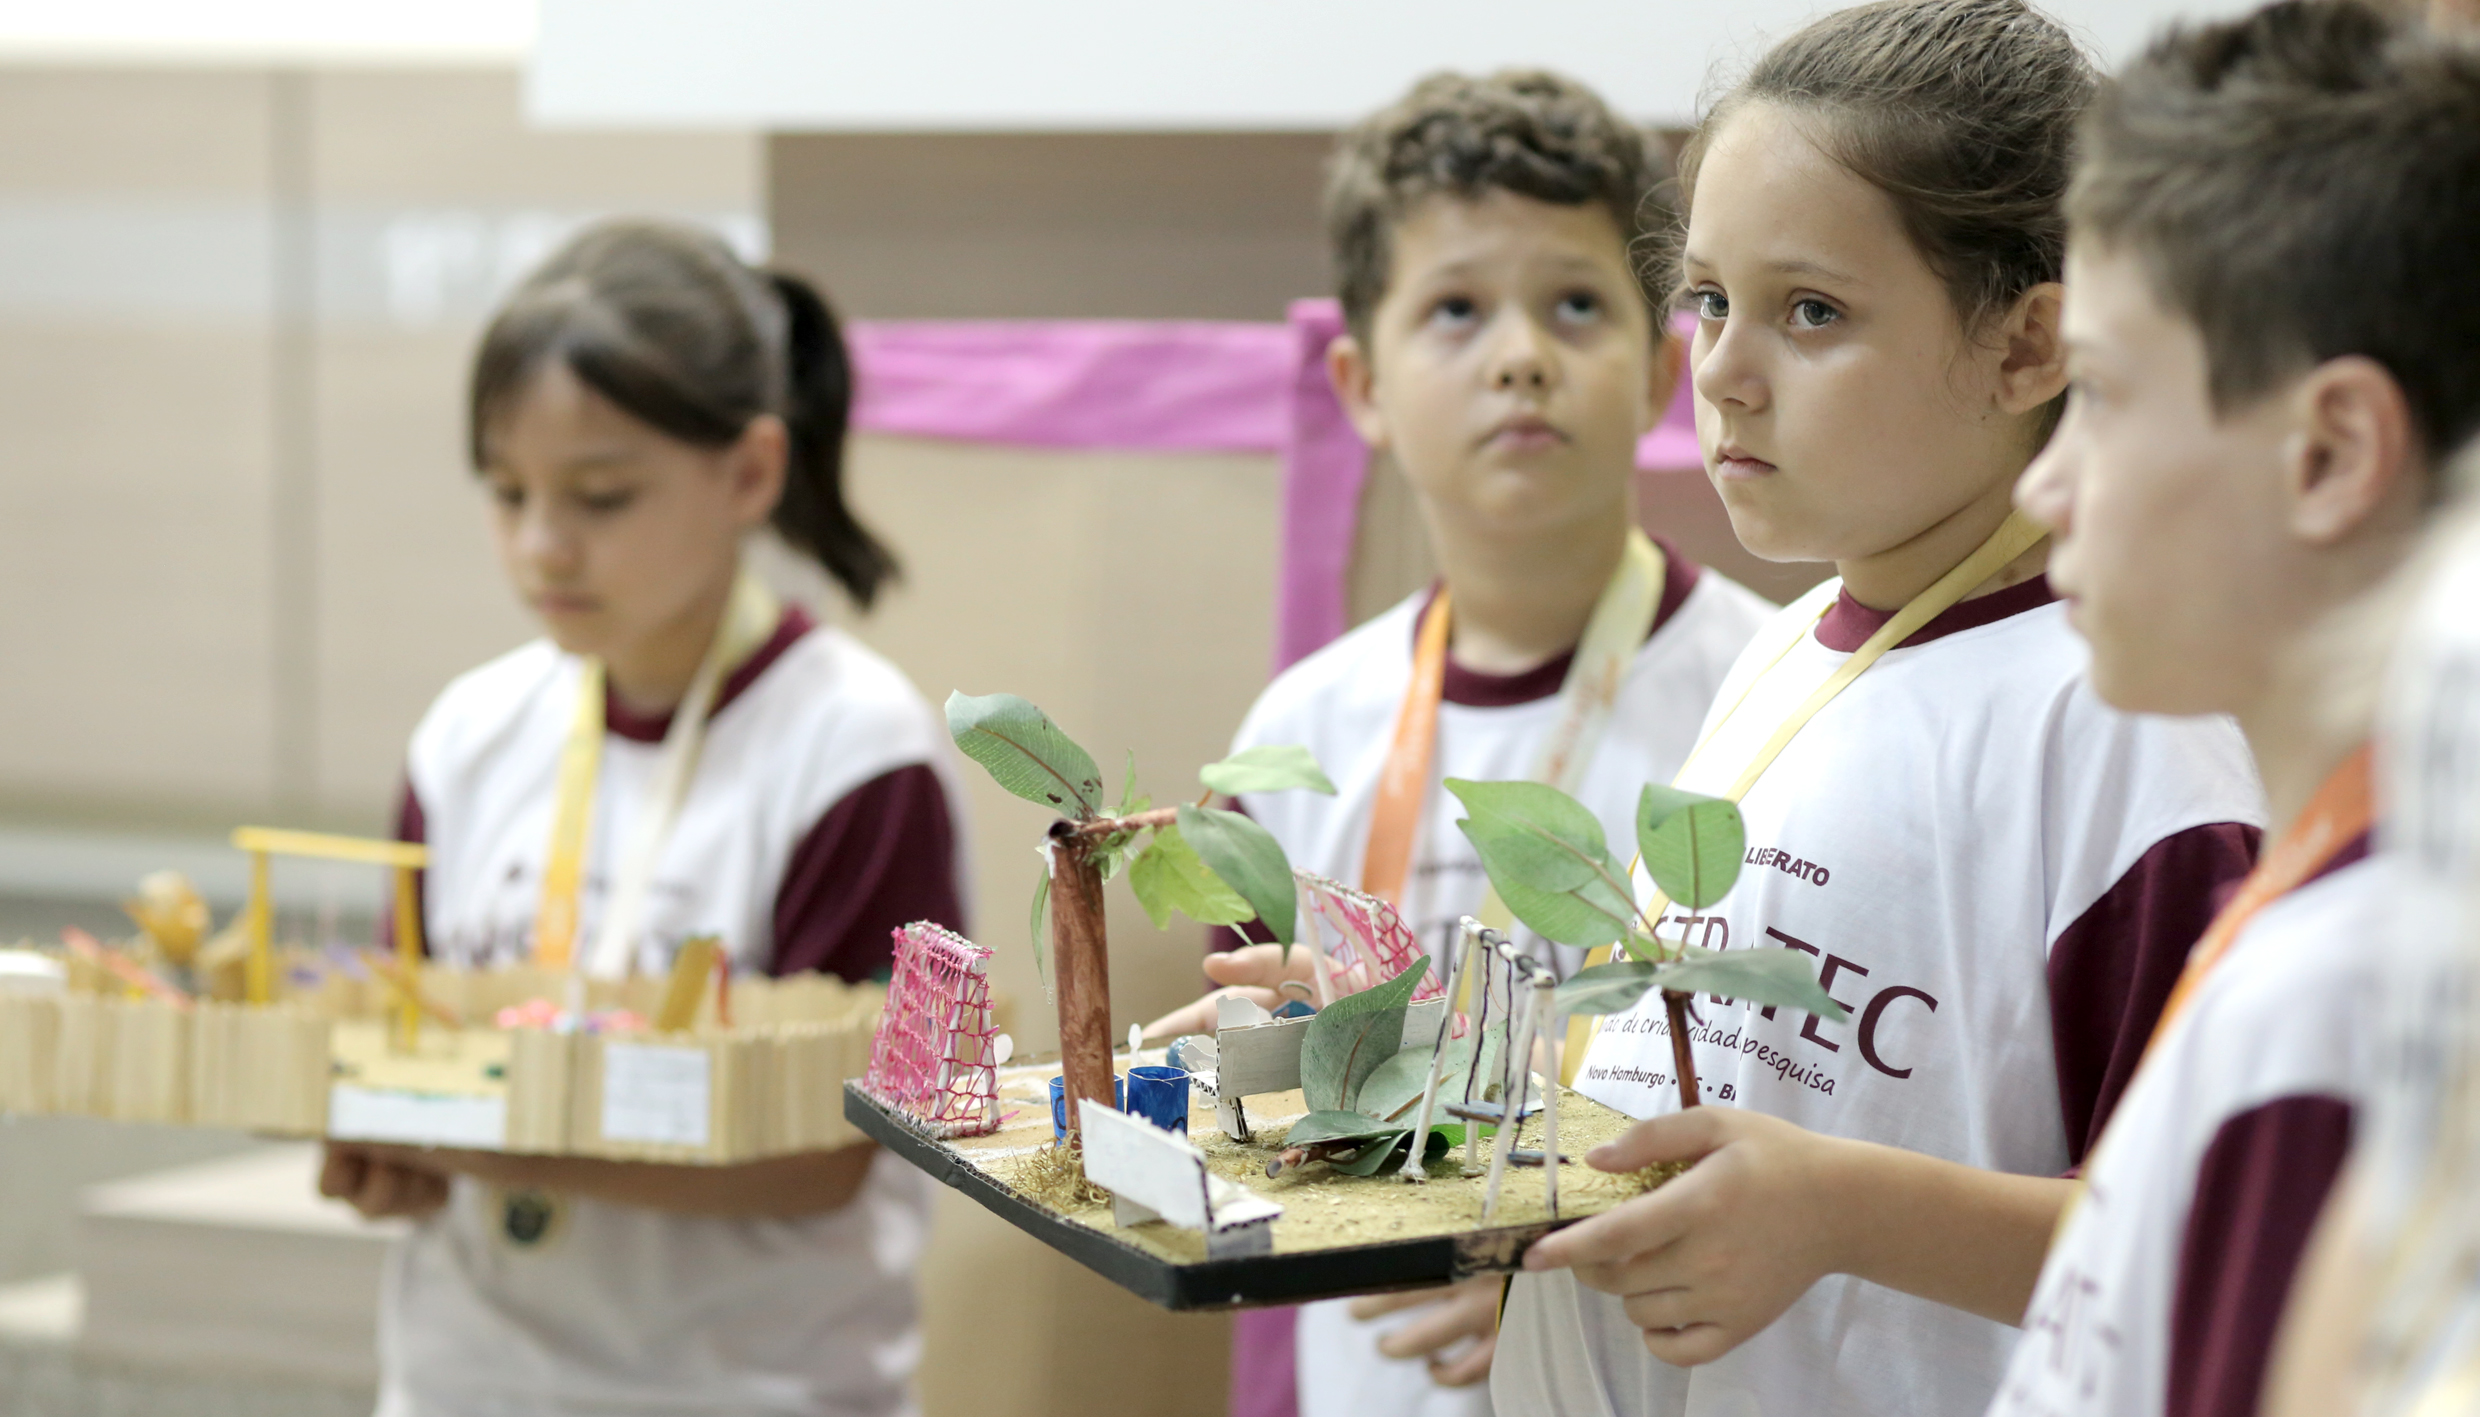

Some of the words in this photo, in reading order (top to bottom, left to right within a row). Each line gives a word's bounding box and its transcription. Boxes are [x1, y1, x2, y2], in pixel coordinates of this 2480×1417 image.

[1745, 846, 1830, 887] LIBERATO
[1586, 1064, 1608, 1081] Novo
[1610, 1064, 1666, 1089] Hamburgo
[1739, 1037, 1836, 1097] pesquisa
